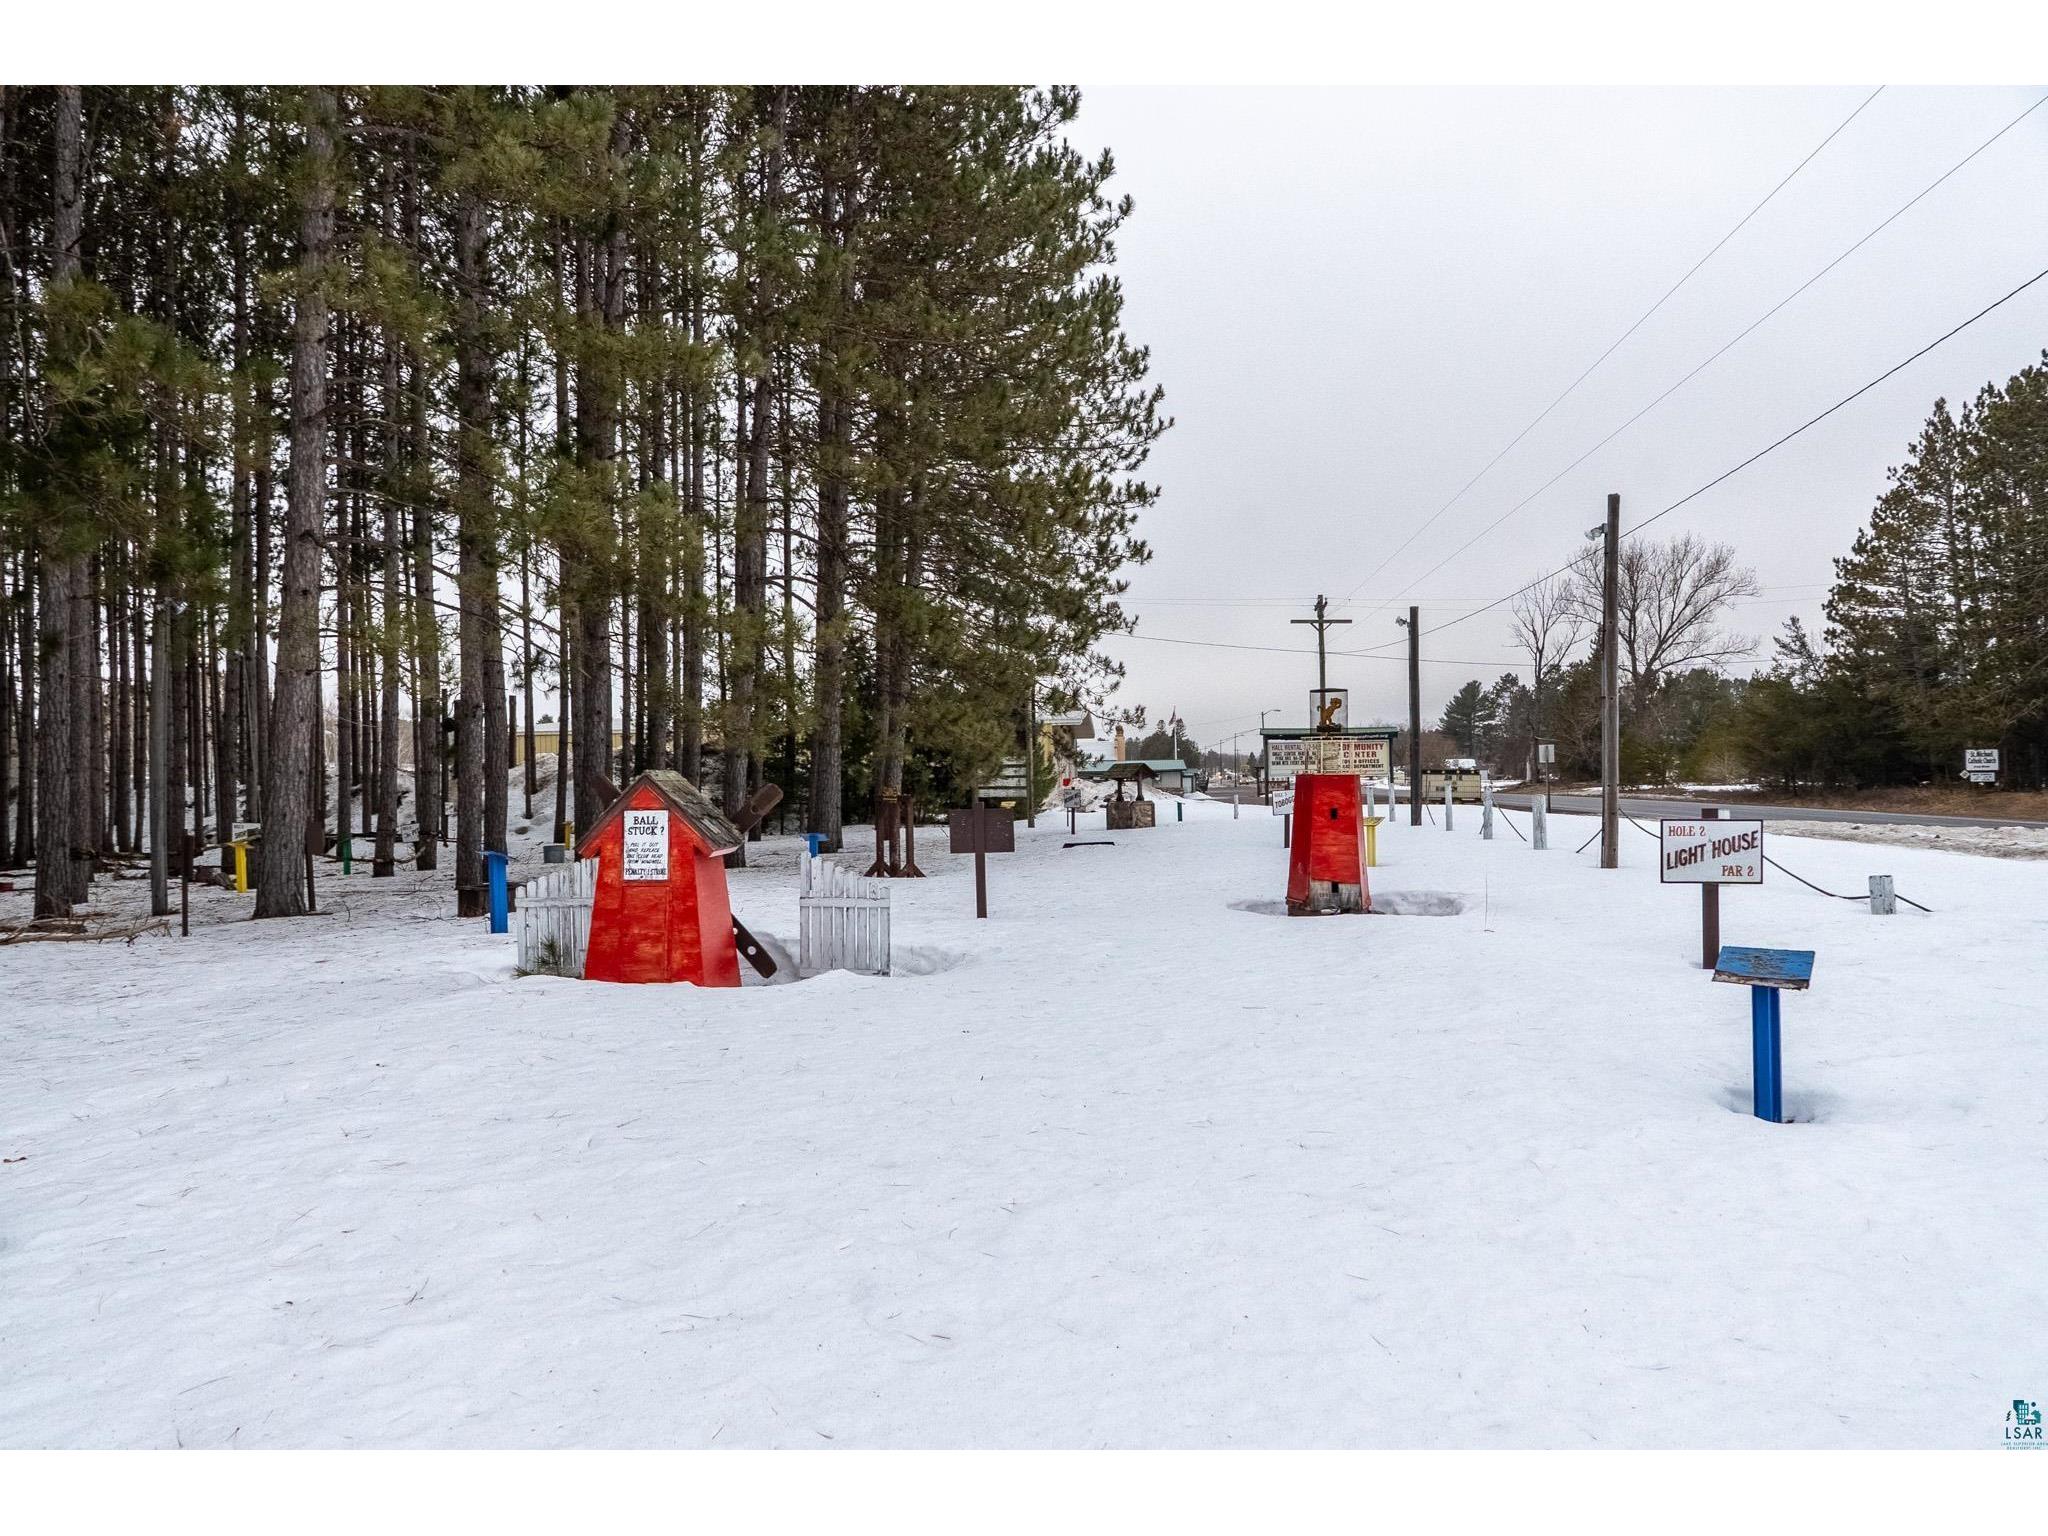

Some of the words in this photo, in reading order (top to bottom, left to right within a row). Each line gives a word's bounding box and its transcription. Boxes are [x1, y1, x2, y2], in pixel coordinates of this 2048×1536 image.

[633, 816, 659, 825] BALL
[627, 826, 658, 836] STUCK
[660, 826, 665, 835] ?
[1668, 826, 1696, 837] HOLE
[1699, 826, 1706, 836] 2
[1666, 843, 1707, 870] LIGHT
[1712, 830, 1759, 859] HOUSE
[625, 867, 646, 876] PENALTY
[1721, 865, 1743, 877] PAR
[1747, 865, 1755, 876] 2
